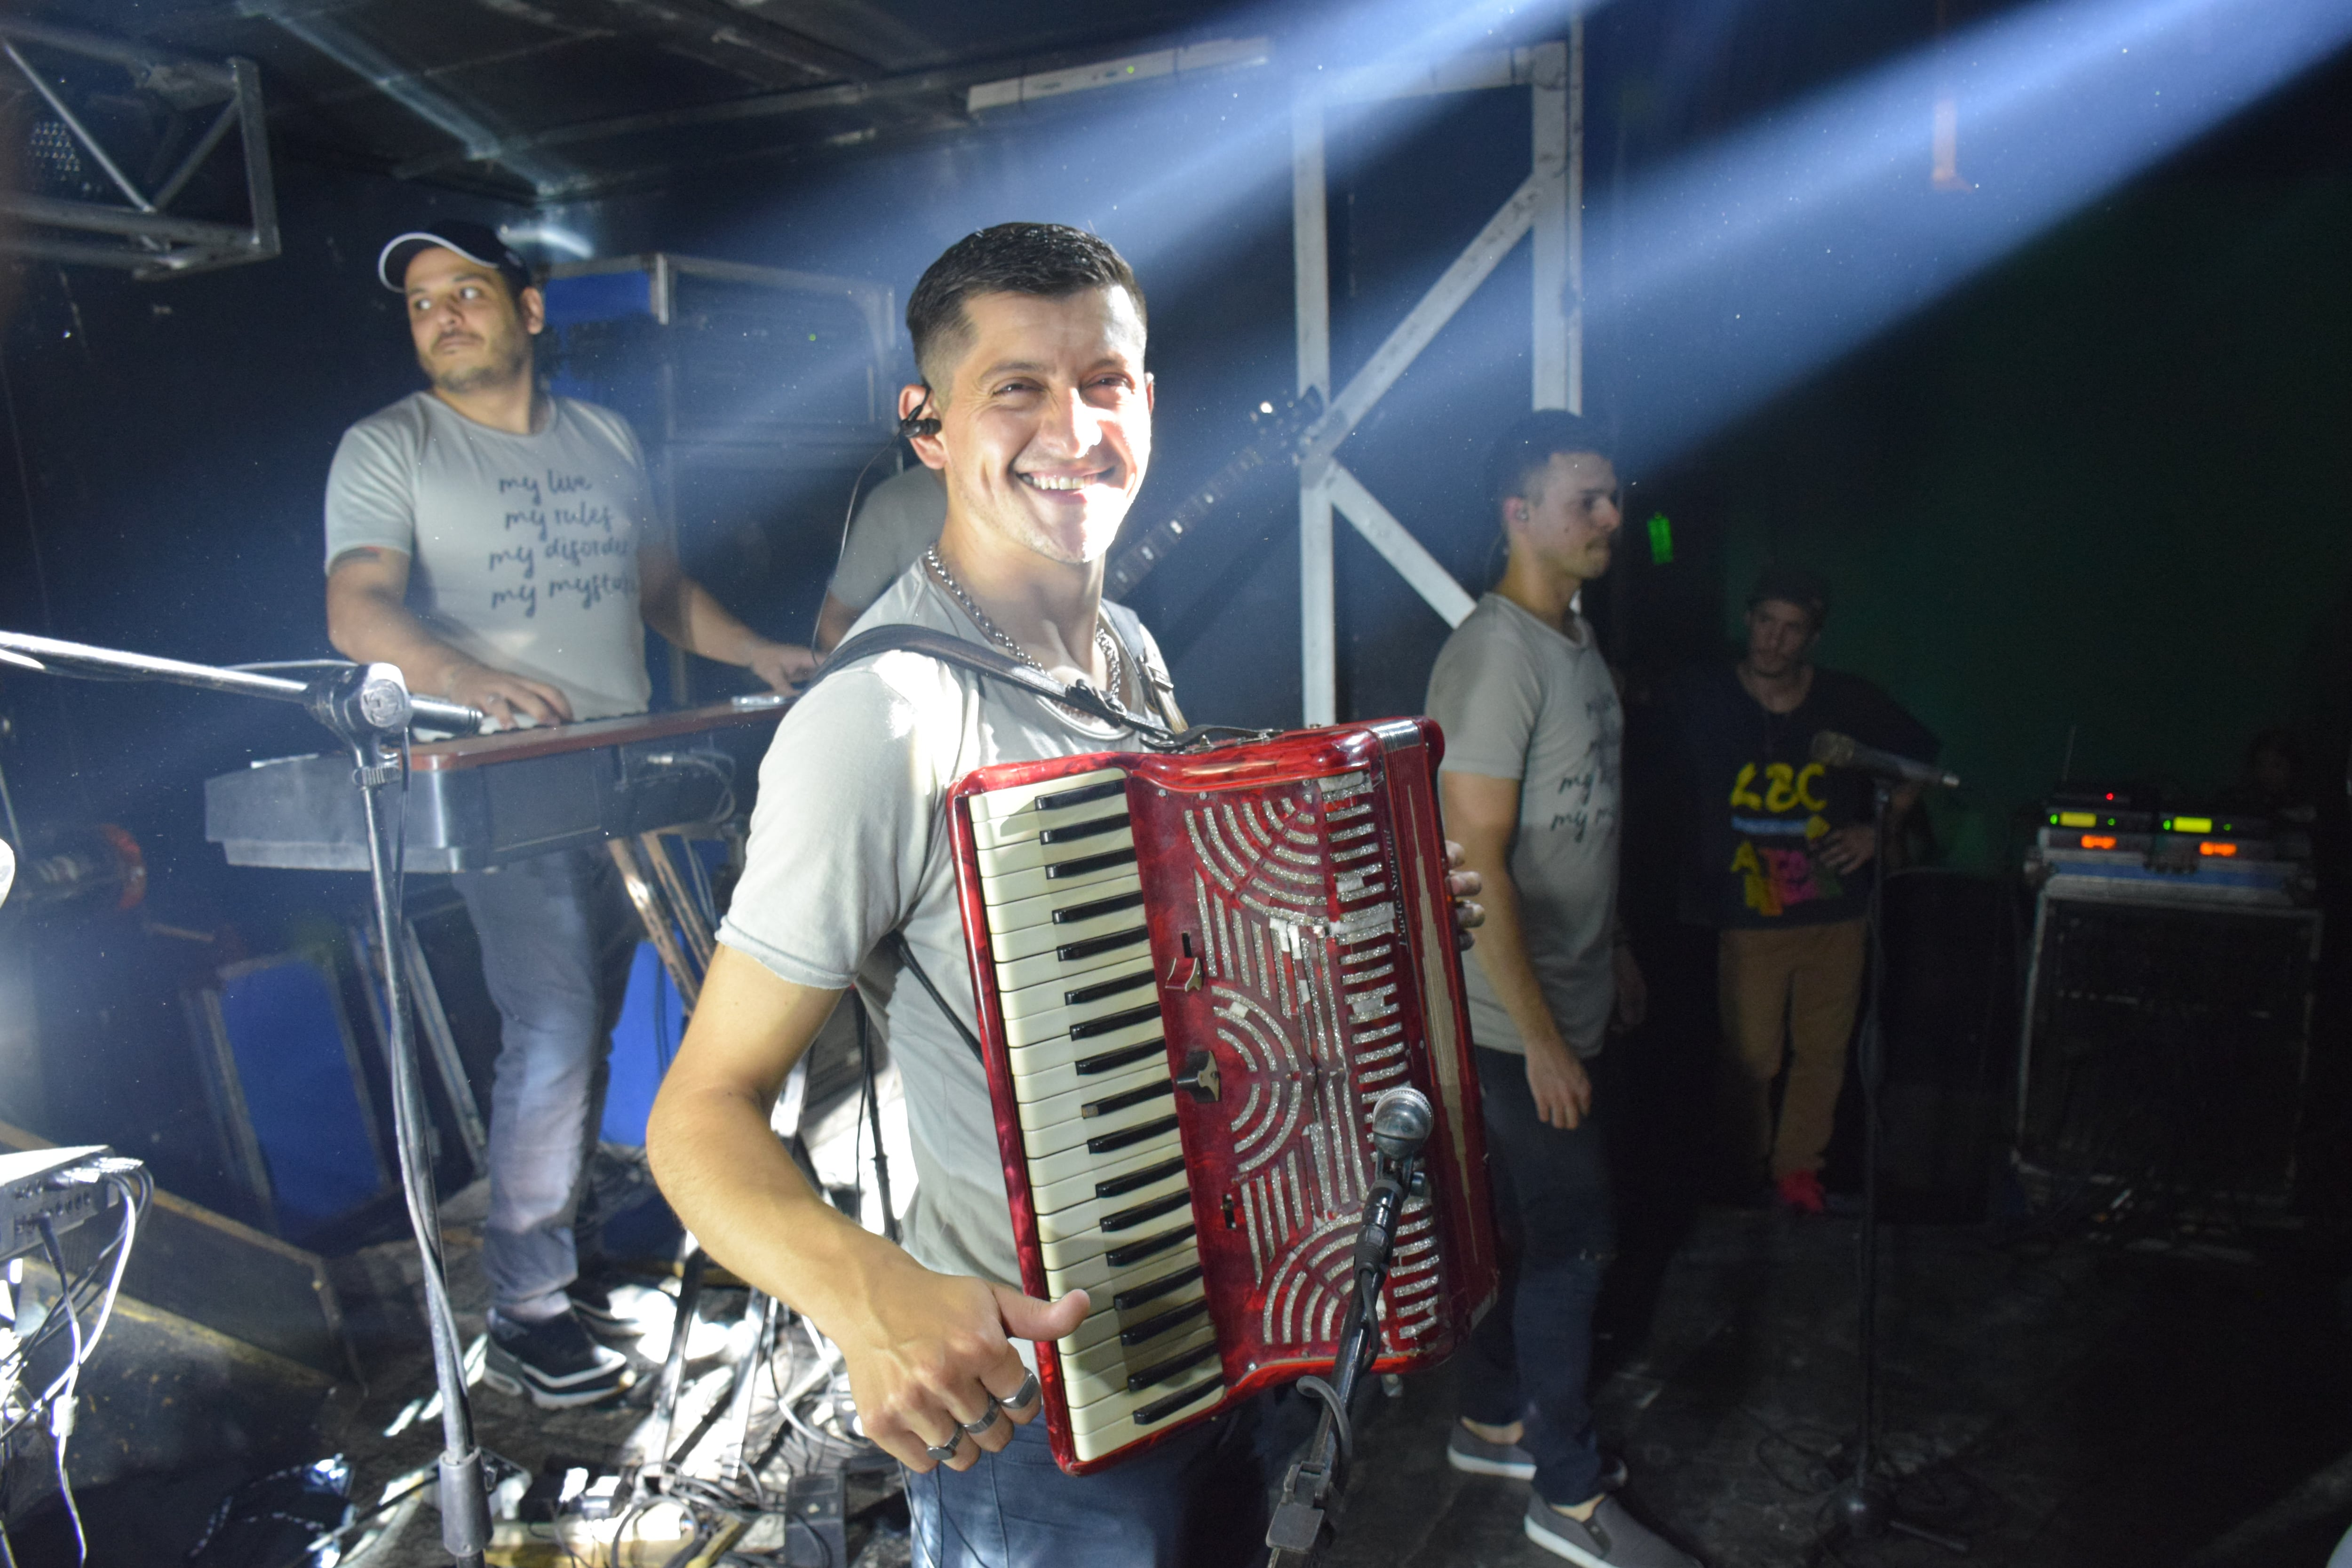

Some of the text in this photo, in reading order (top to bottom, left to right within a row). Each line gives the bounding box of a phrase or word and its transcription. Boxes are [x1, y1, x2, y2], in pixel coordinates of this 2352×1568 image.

[498, 476, 541, 506] my
[505, 509, 548, 542] my
[489, 545, 534, 579] my
[492, 584, 536, 619] my
[1550, 810, 1588, 844] my
[1383, 828, 1409, 949] Paolo Soprani
